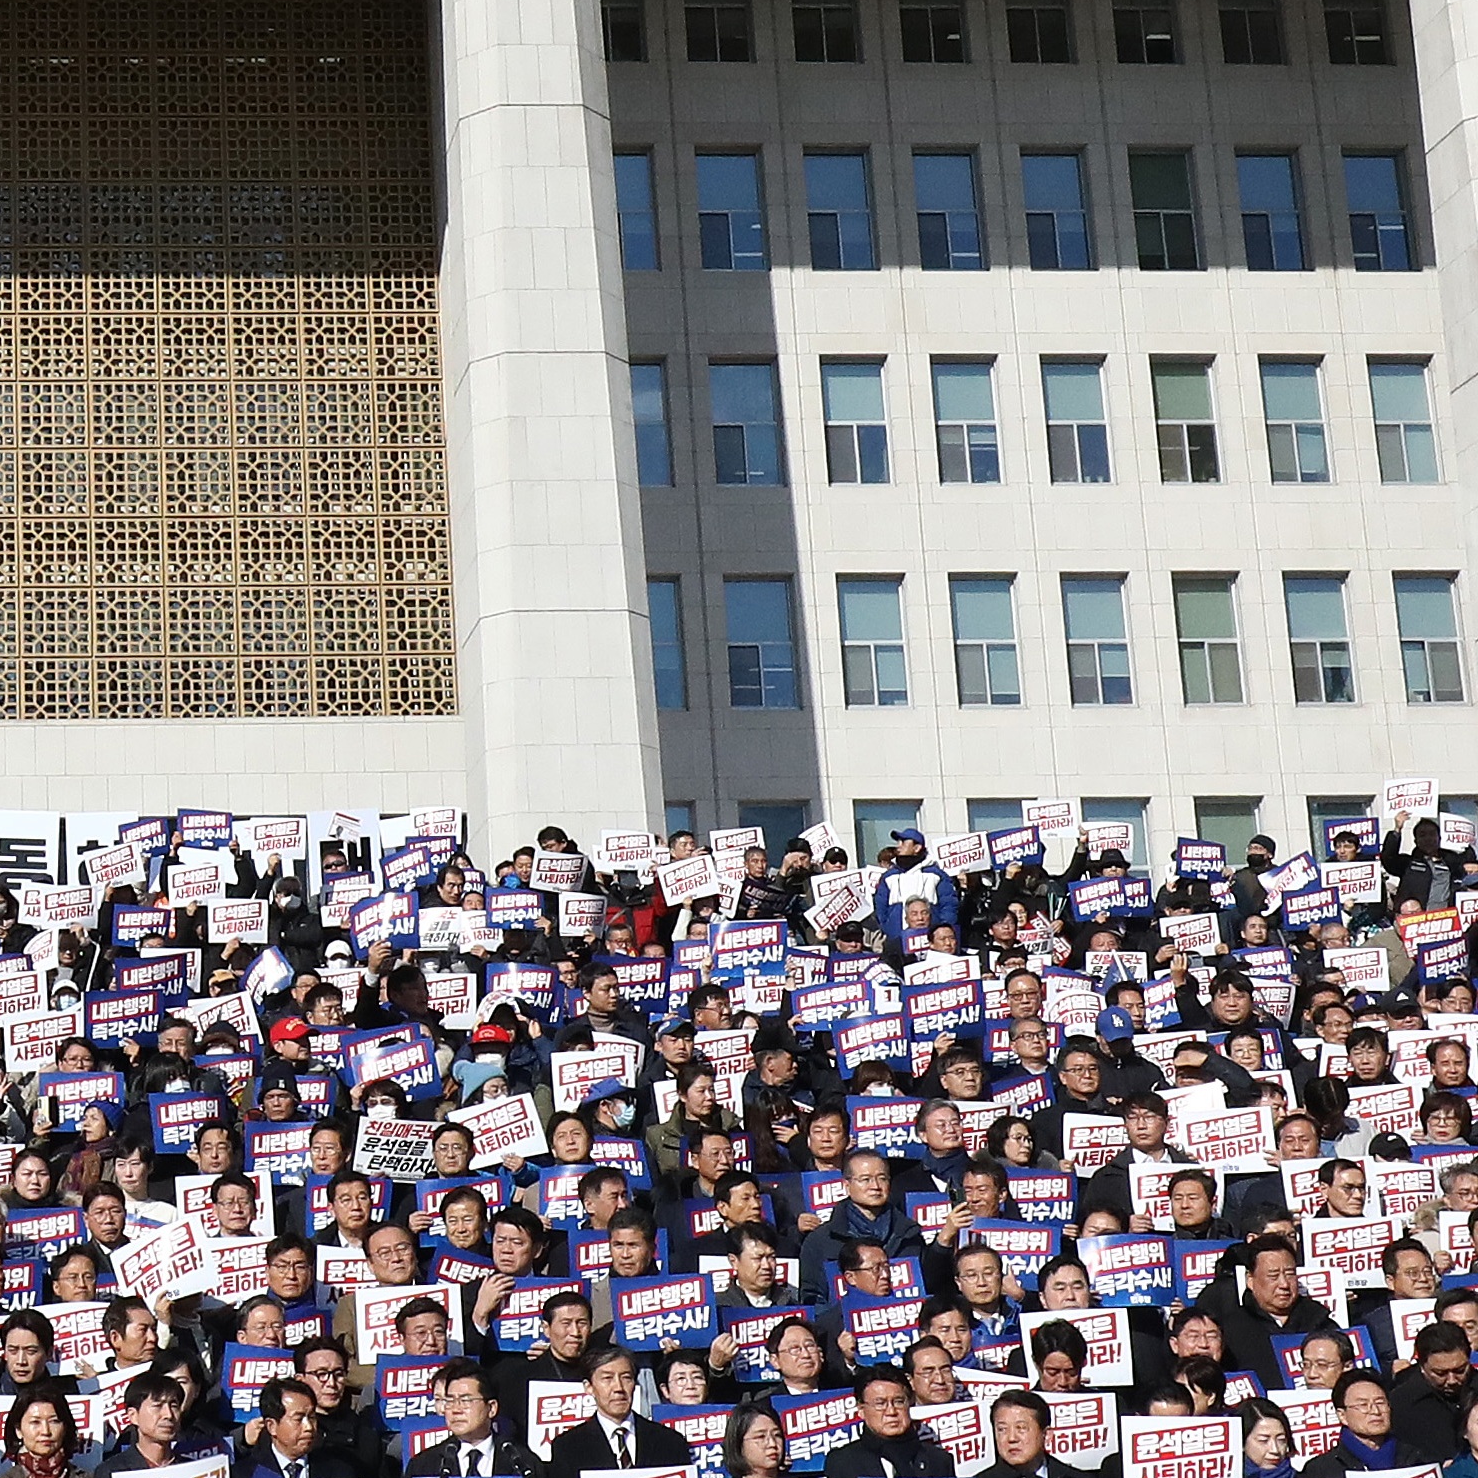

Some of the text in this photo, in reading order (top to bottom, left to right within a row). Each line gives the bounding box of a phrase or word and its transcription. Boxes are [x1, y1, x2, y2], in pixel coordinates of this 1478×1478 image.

[1385, 782, 1433, 800] 윤석열은
[1386, 796, 1435, 811] 사퇴하라!
[663, 861, 712, 884] 윤석열은
[715, 926, 779, 947] 내란행위
[715, 943, 784, 968] 즉각수사!
[89, 997, 156, 1021] 내란행위
[908, 986, 977, 1015] 내란행위
[91, 1015, 159, 1042] 즉각수사!
[839, 1015, 903, 1047] 내란행위
[911, 1006, 980, 1034] 즉각수사!
[843, 1039, 909, 1067] 즉각수사!
[468, 1100, 526, 1135] 윤석열은
[1187, 1111, 1259, 1142] 윤석열은
[361, 1137, 428, 1156] 윤석열을
[475, 1120, 536, 1156] 사퇴하라!
[1196, 1133, 1268, 1162] 사퇴하라!
[1092, 1240, 1167, 1277] 내란행위
[1093, 1265, 1172, 1298] 즉각수사!
[620, 1281, 705, 1318] 내란행위
[624, 1307, 710, 1342] 즉각수사!
[1134, 1422, 1227, 1460] 윤석열은
